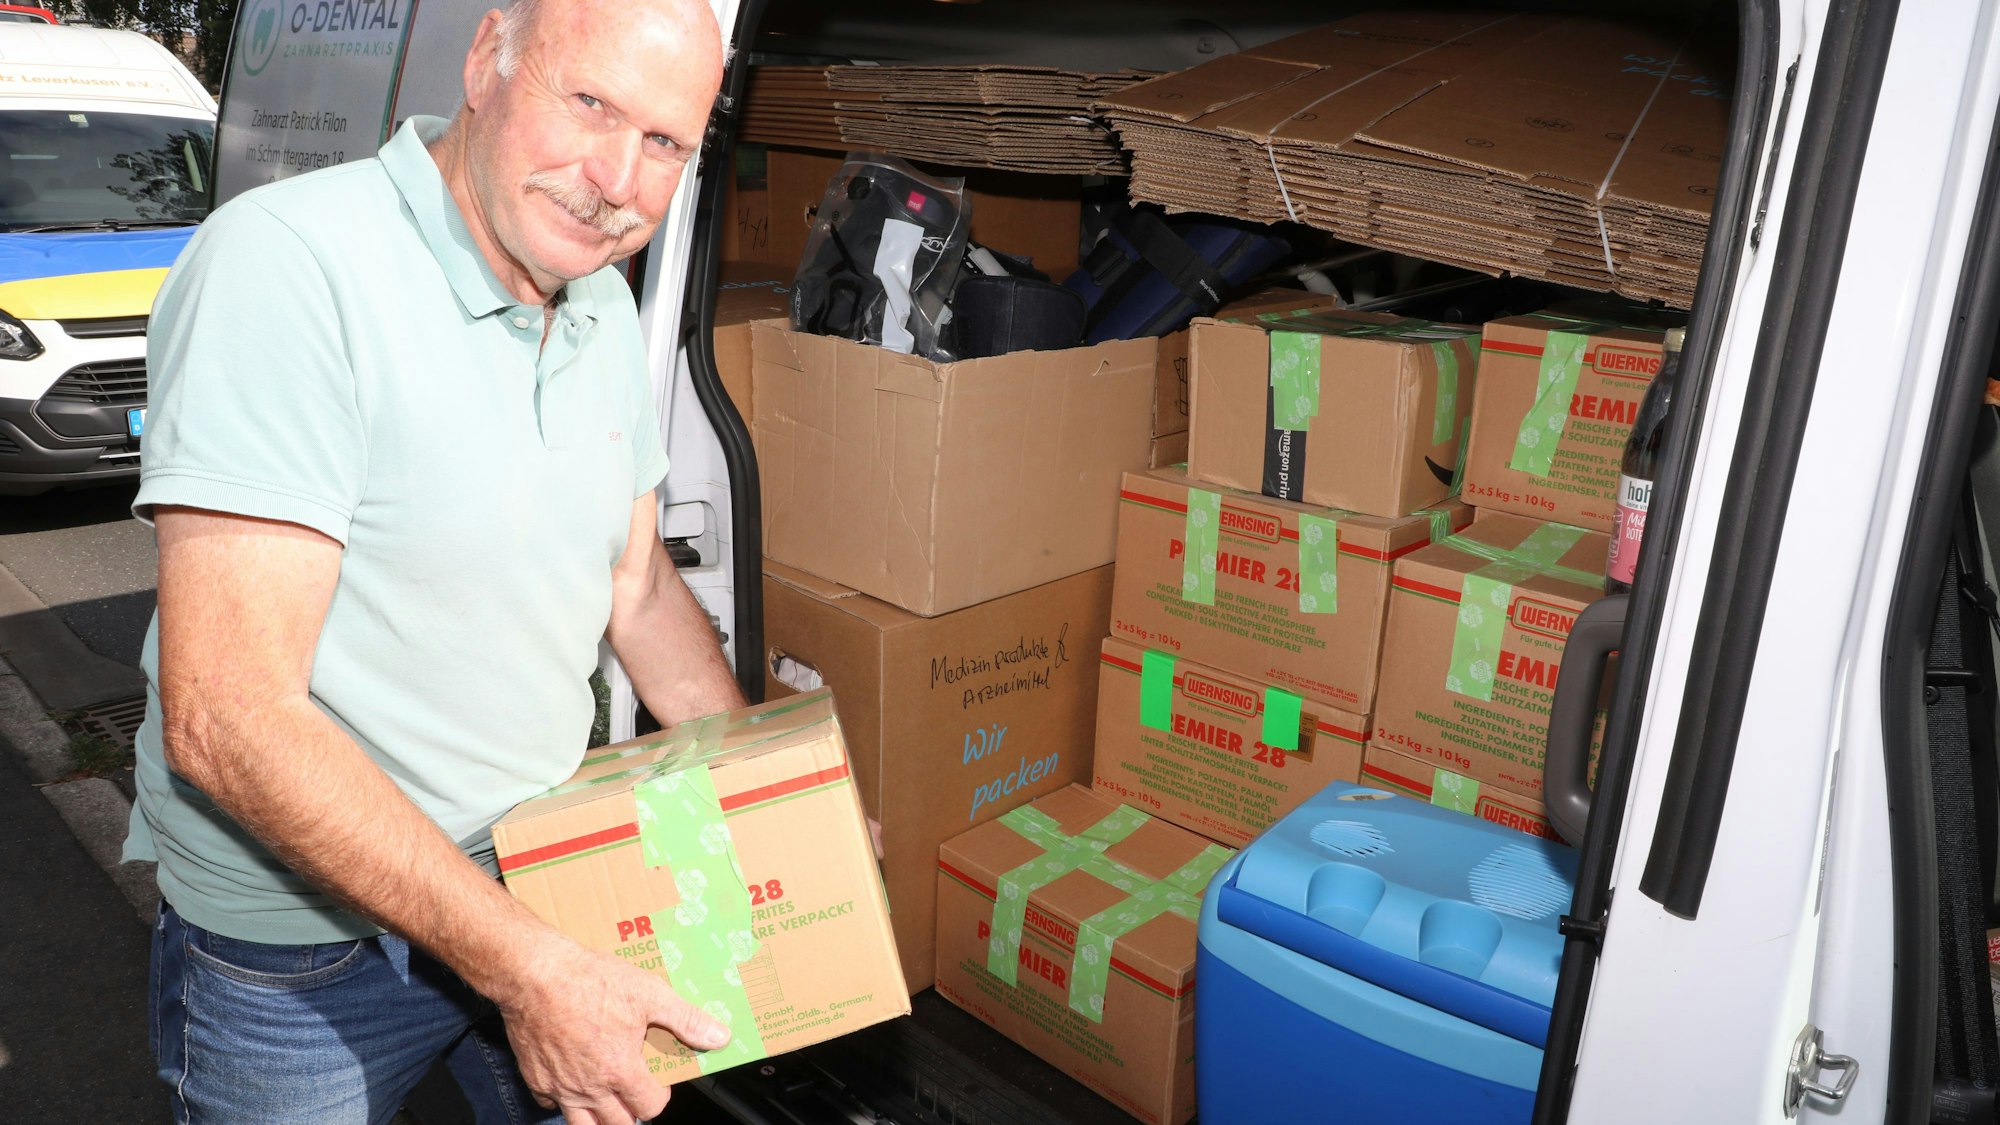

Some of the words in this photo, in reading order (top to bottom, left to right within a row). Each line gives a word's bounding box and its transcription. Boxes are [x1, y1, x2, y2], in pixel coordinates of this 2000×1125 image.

[291, 0, 399, 33] O-DENTAL
[284, 42, 394, 57] ZAHNARZTPRAXIS
[21, 74, 120, 87] Leverkusen
[126, 81, 152, 89] e.V.
[251, 110, 289, 130] Zahnarzt
[290, 111, 320, 132] Patrick
[322, 112, 347, 132] Filon
[257, 144, 329, 170] Schmittergarten
[1600, 351, 1662, 375] WERNS
[1601, 377, 1614, 386] Für
[1614, 381, 1631, 390] gute
[1569, 393, 1638, 425] REMI
[1571, 420, 1612, 435] FRISCHE
[1614, 427, 1628, 438] PO
[1281, 429, 1292, 470] amazon
[1552, 458, 1593, 474] UTATEN:
[1595, 467, 1622, 479] KART
[1571, 474, 1615, 489] POMMES
[1278, 470, 1290, 499] prim
[1468, 483, 1476, 493] 2
[1486, 486, 1493, 497] 5
[1495, 488, 1510, 502] kg
[1525, 494, 1538, 506] 10
[1541, 496, 1556, 512] kg
[1528, 477, 1601, 498] INGREDIENSER:
[1219, 511, 1275, 537] ERNSING
[1627, 512, 1646, 527] Mil
[1626, 527, 1643, 542] ROTE
[1169, 538, 1265, 584] PMIER
[1215, 600, 1260, 619] PROTECTIVE
[1261, 613, 1317, 635] ATMOSPHERE
[1236, 594, 1266, 610] FRENCH
[1268, 603, 1289, 617] FRIES
[1520, 605, 1574, 634] WERN
[1116, 620, 1122, 630] 2
[1129, 624, 1135, 633] 5
[1136, 625, 1147, 639] kg
[1158, 633, 1168, 644] 10
[1170, 636, 1181, 650] kg
[1164, 605, 1193, 620] PAKKED
[1200, 616, 1249, 638] BESKYTTENDE
[1198, 605, 1218, 618] SOUS
[1273, 627, 1327, 650] PROTECTRICE
[1519, 634, 1533, 643] Für
[1534, 640, 1552, 648] gute
[1187, 678, 1253, 711] WERNSING
[1493, 679, 1530, 697] RISCHE
[1453, 700, 1525, 729] INGREDIENTS:
[1528, 724, 1549, 736] POT
[1460, 714, 1509, 737] ZUTATEN:
[1168, 734, 1197, 750] FRISCHE
[1199, 745, 1233, 763] POMMES
[1234, 757, 1259, 772] FRITES
[1171, 713, 1243, 755] EMIER
[1251, 741, 1286, 769] 28
[1378, 727, 1385, 739] 2
[1388, 733, 1395, 742] x
[1397, 735, 1404, 745] 5
[1407, 737, 1422, 753] kg
[1438, 747, 1452, 760] 10
[1455, 752, 1471, 769] kg
[1441, 730, 1518, 762] INGREDIENSER:
[1521, 757, 1544, 770] KAR
[1487, 735, 1534, 756] POMMES
[1140, 734, 1164, 749] UNTER
[1247, 772, 1289, 793] VERPACKT
[1152, 763, 1186, 782] ZUTATEN:
[969, 752, 1059, 822] packen
[1095, 776, 1101, 785] 2
[1109, 781, 1115, 790] 5
[1116, 783, 1127, 797] kg
[1138, 792, 1149, 802] 10
[1150, 795, 1161, 809] kg
[1139, 777, 1193, 802] INGREDIENSER:
[1146, 752, 1196, 776] INGREDIENTS:
[1240, 786, 1263, 800] PALM
[1265, 795, 1279, 806] OIL
[1170, 780, 1204, 797] POMMES
[1205, 793, 1215, 801] DE
[1243, 806, 1265, 820] HUILE
[616, 915, 655, 943] PR
[747, 879, 784, 906] 28
[779, 900, 854, 931] VERPACKT
[1024, 905, 1075, 946] ERNSING
[614, 939, 660, 959] FRISC
[751, 900, 795, 924] FRITES
[977, 920, 1066, 991] PMIER
[763, 1005, 795, 1020] GmbH
[829, 993, 873, 1011] Germany
[663, 1060, 677, 1072] (0)
[679, 1055, 692, 1066] 54
